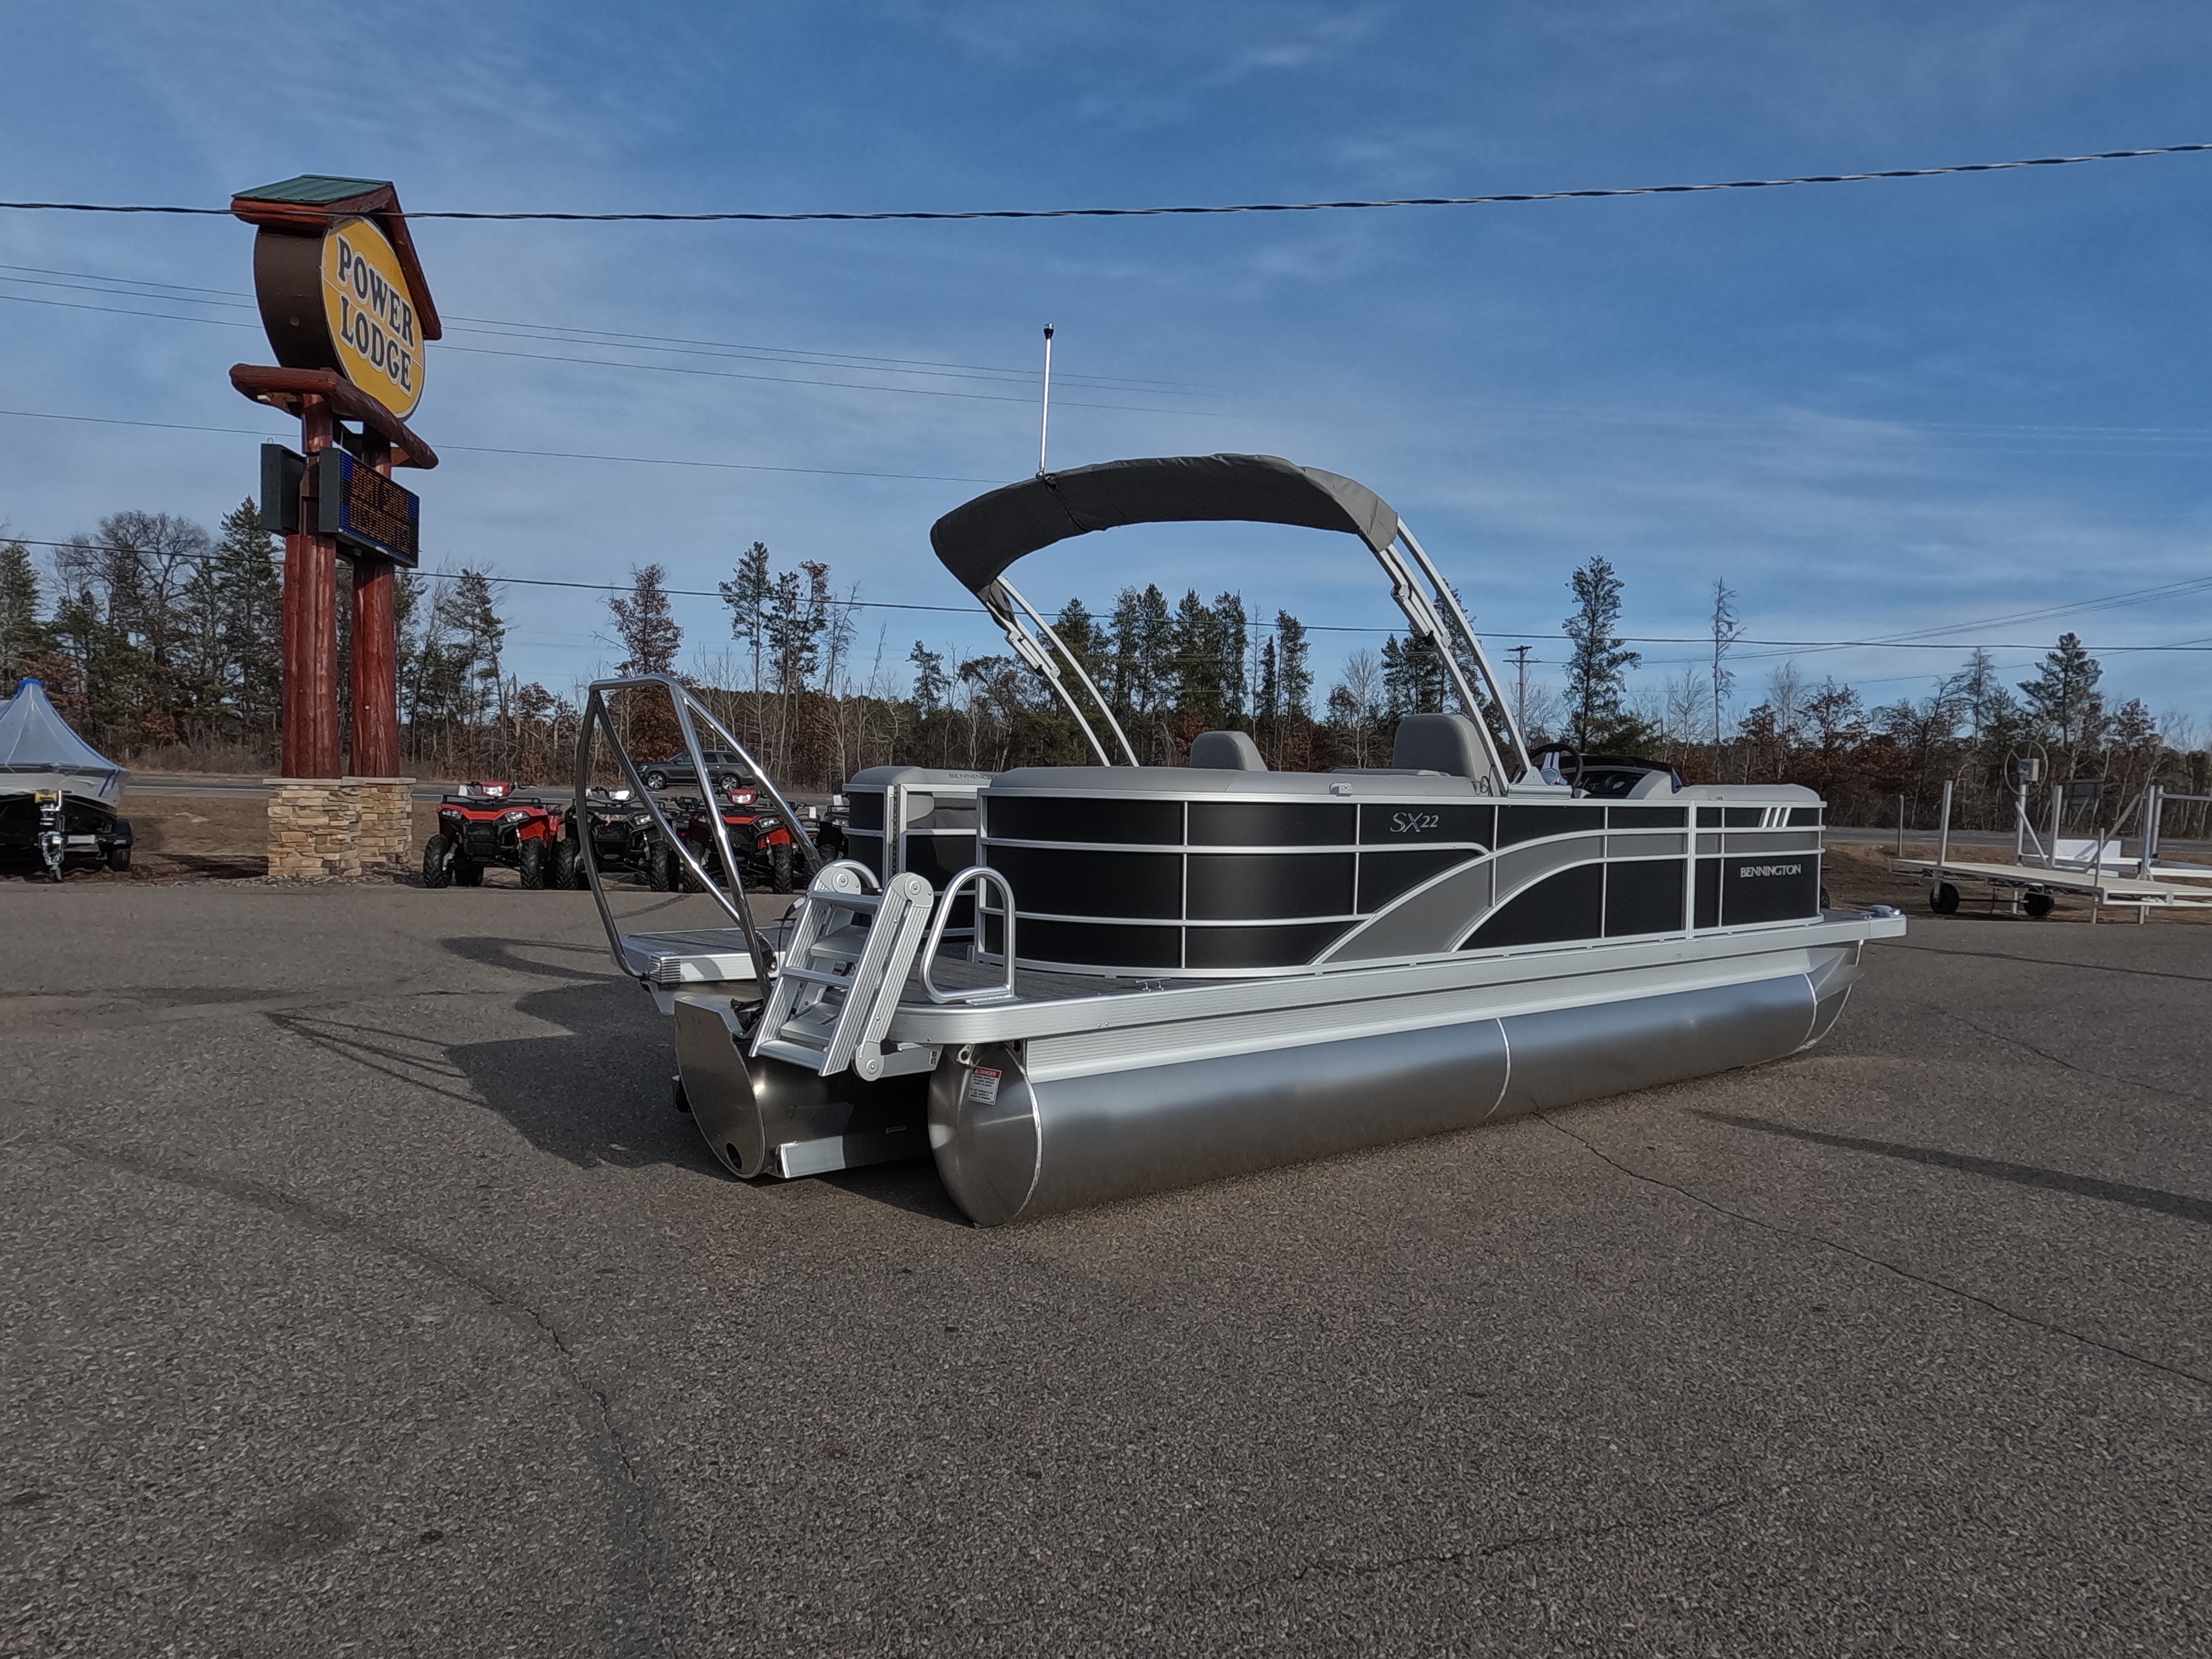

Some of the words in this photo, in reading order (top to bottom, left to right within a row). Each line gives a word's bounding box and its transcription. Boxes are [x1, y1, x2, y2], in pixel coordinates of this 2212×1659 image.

[338, 235, 414, 349] POWER
[341, 295, 411, 393] LODGE
[1390, 812, 1439, 832] SX22
[1740, 864, 1801, 878] BENNINGTON
